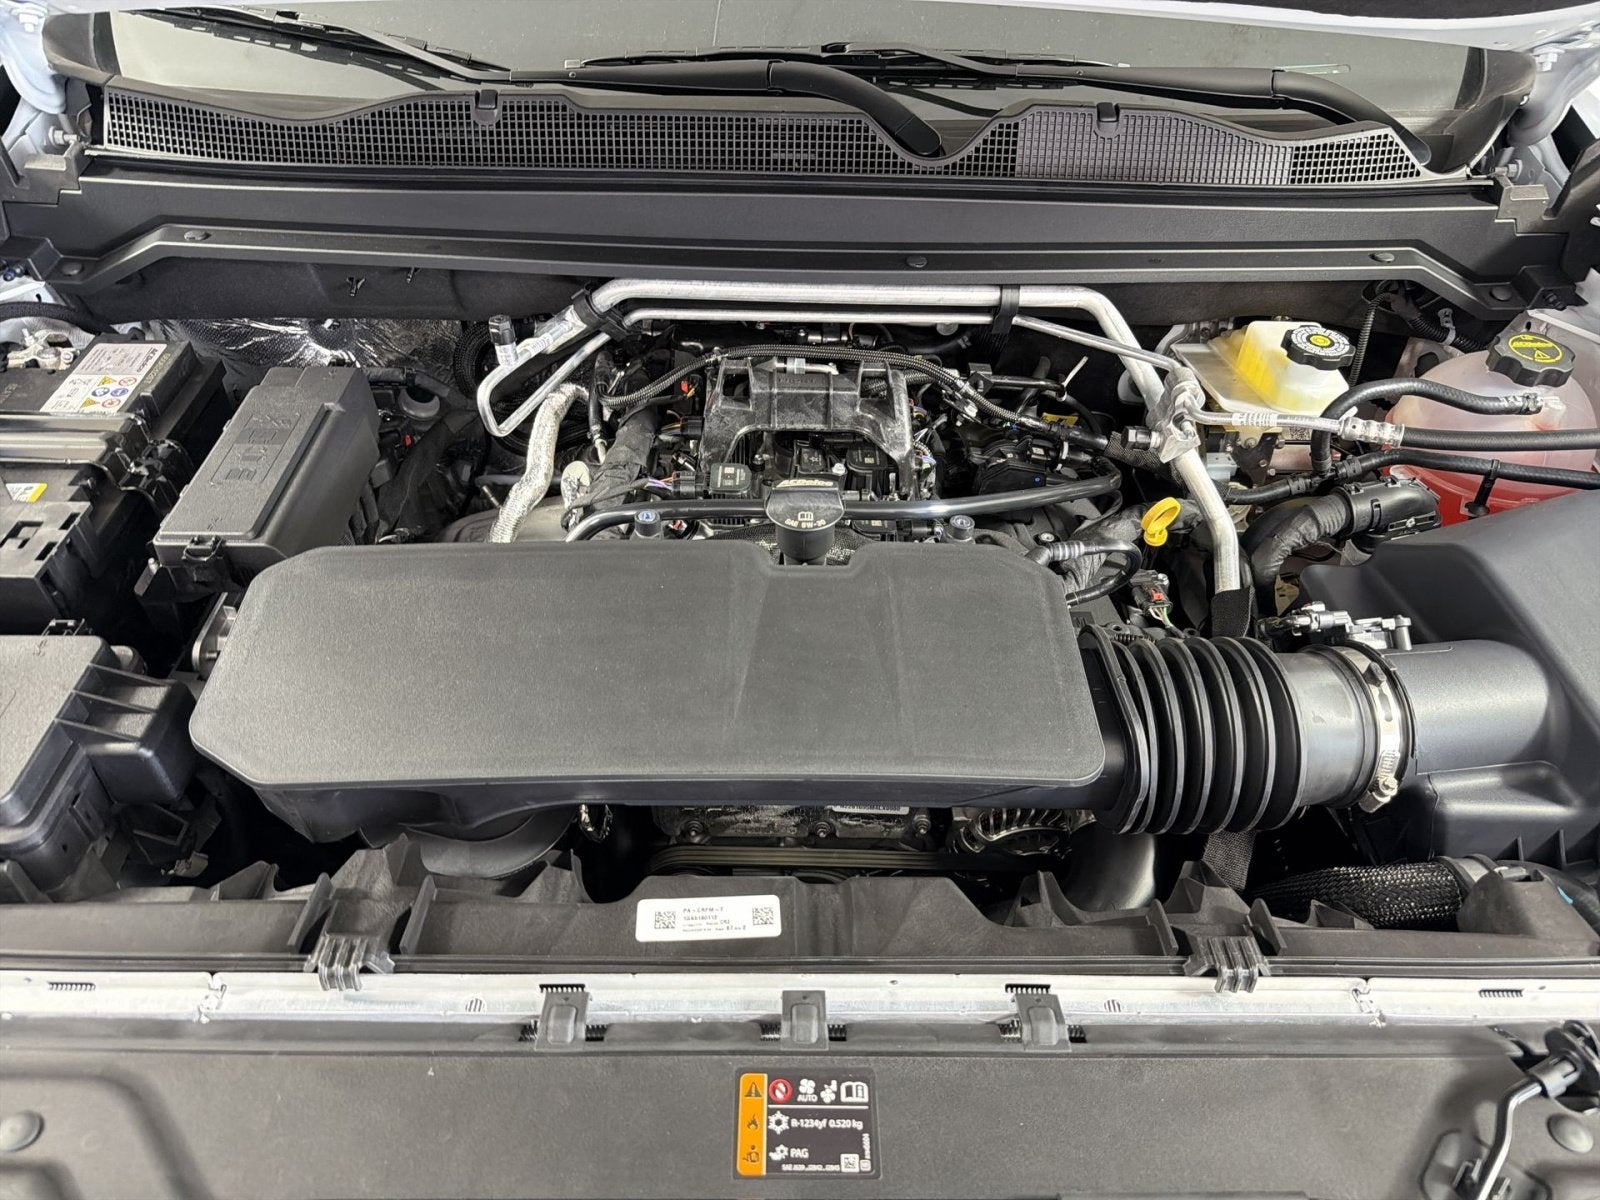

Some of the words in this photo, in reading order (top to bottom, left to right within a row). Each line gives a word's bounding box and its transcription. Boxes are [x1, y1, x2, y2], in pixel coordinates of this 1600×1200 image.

[797, 1094, 818, 1103] AUTO
[790, 1118, 827, 1130] R-1234yf
[828, 1118, 852, 1128] 0.520
[852, 1119, 863, 1131] kg
[790, 1148, 809, 1158] PAG
